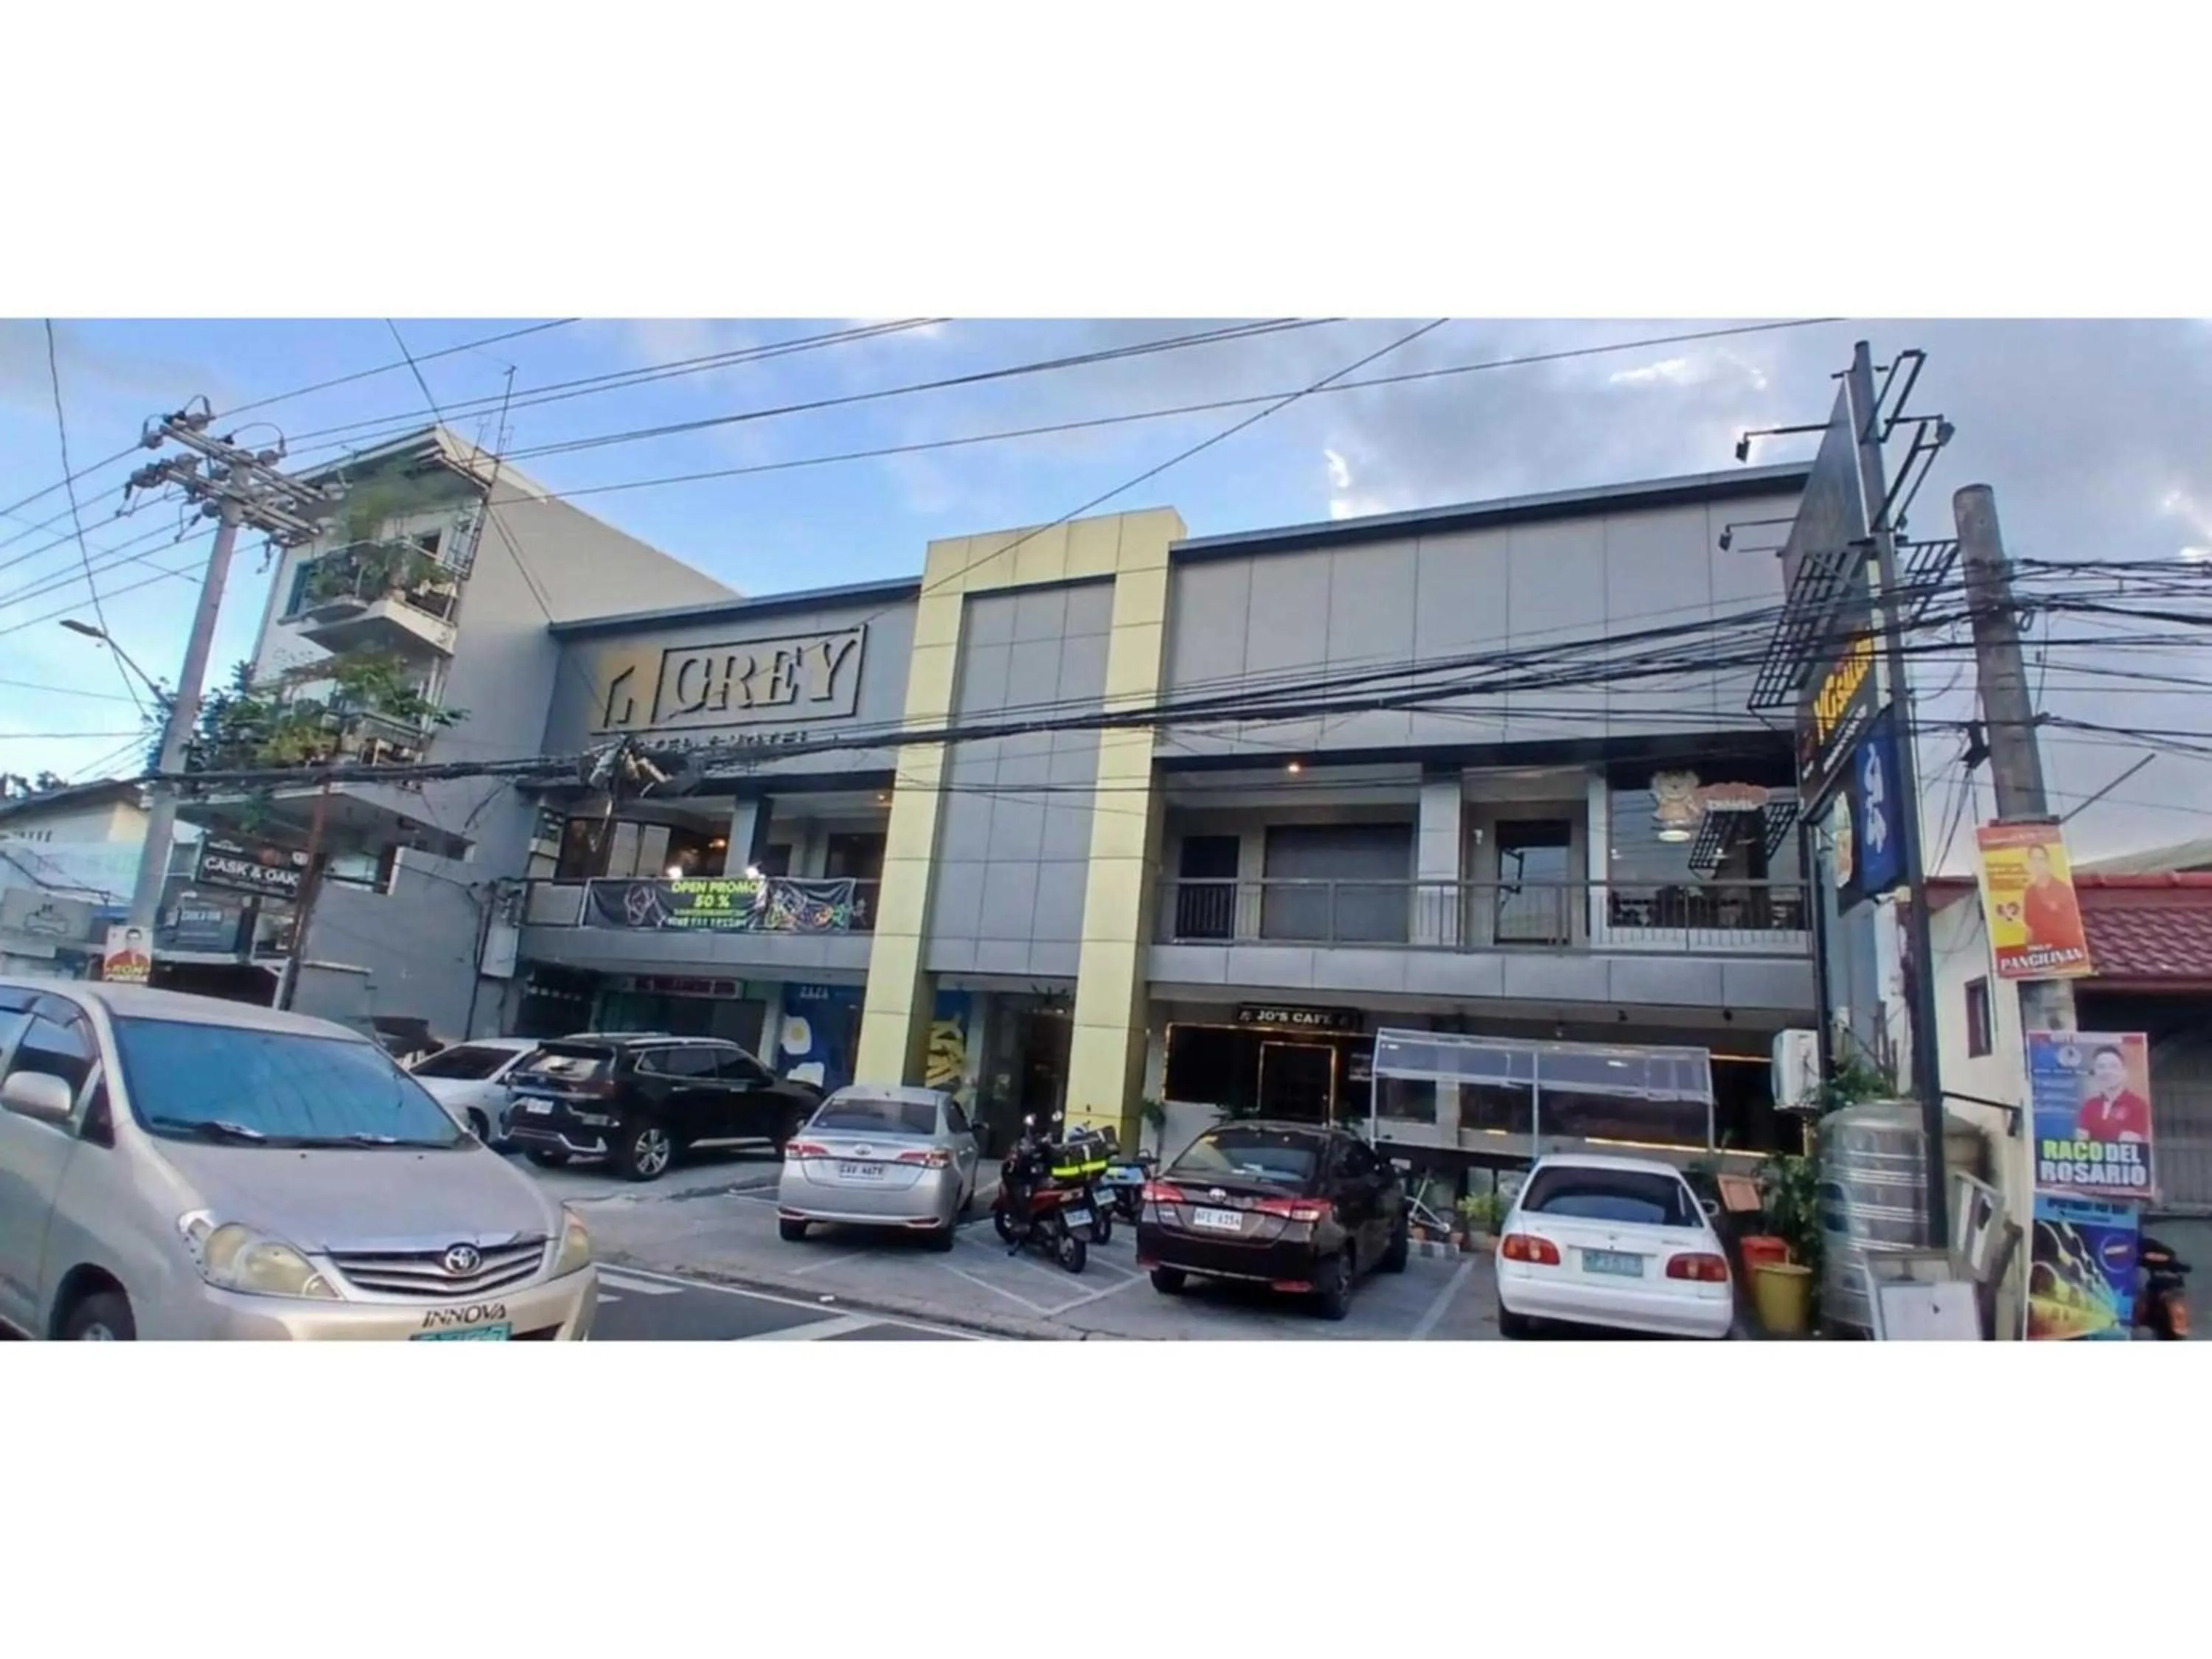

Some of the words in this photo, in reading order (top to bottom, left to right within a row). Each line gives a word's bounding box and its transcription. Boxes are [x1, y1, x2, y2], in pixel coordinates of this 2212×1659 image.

[204, 856, 248, 877] CASK
[671, 879, 706, 894] OPEN
[1256, 1009, 1289, 1023] JO'S
[2042, 1139, 2104, 1162] RACO
[2105, 1143, 2142, 1164] DEL
[2040, 1160, 2147, 1186] ROSARIO
[422, 1304, 506, 1328] INNOVA
